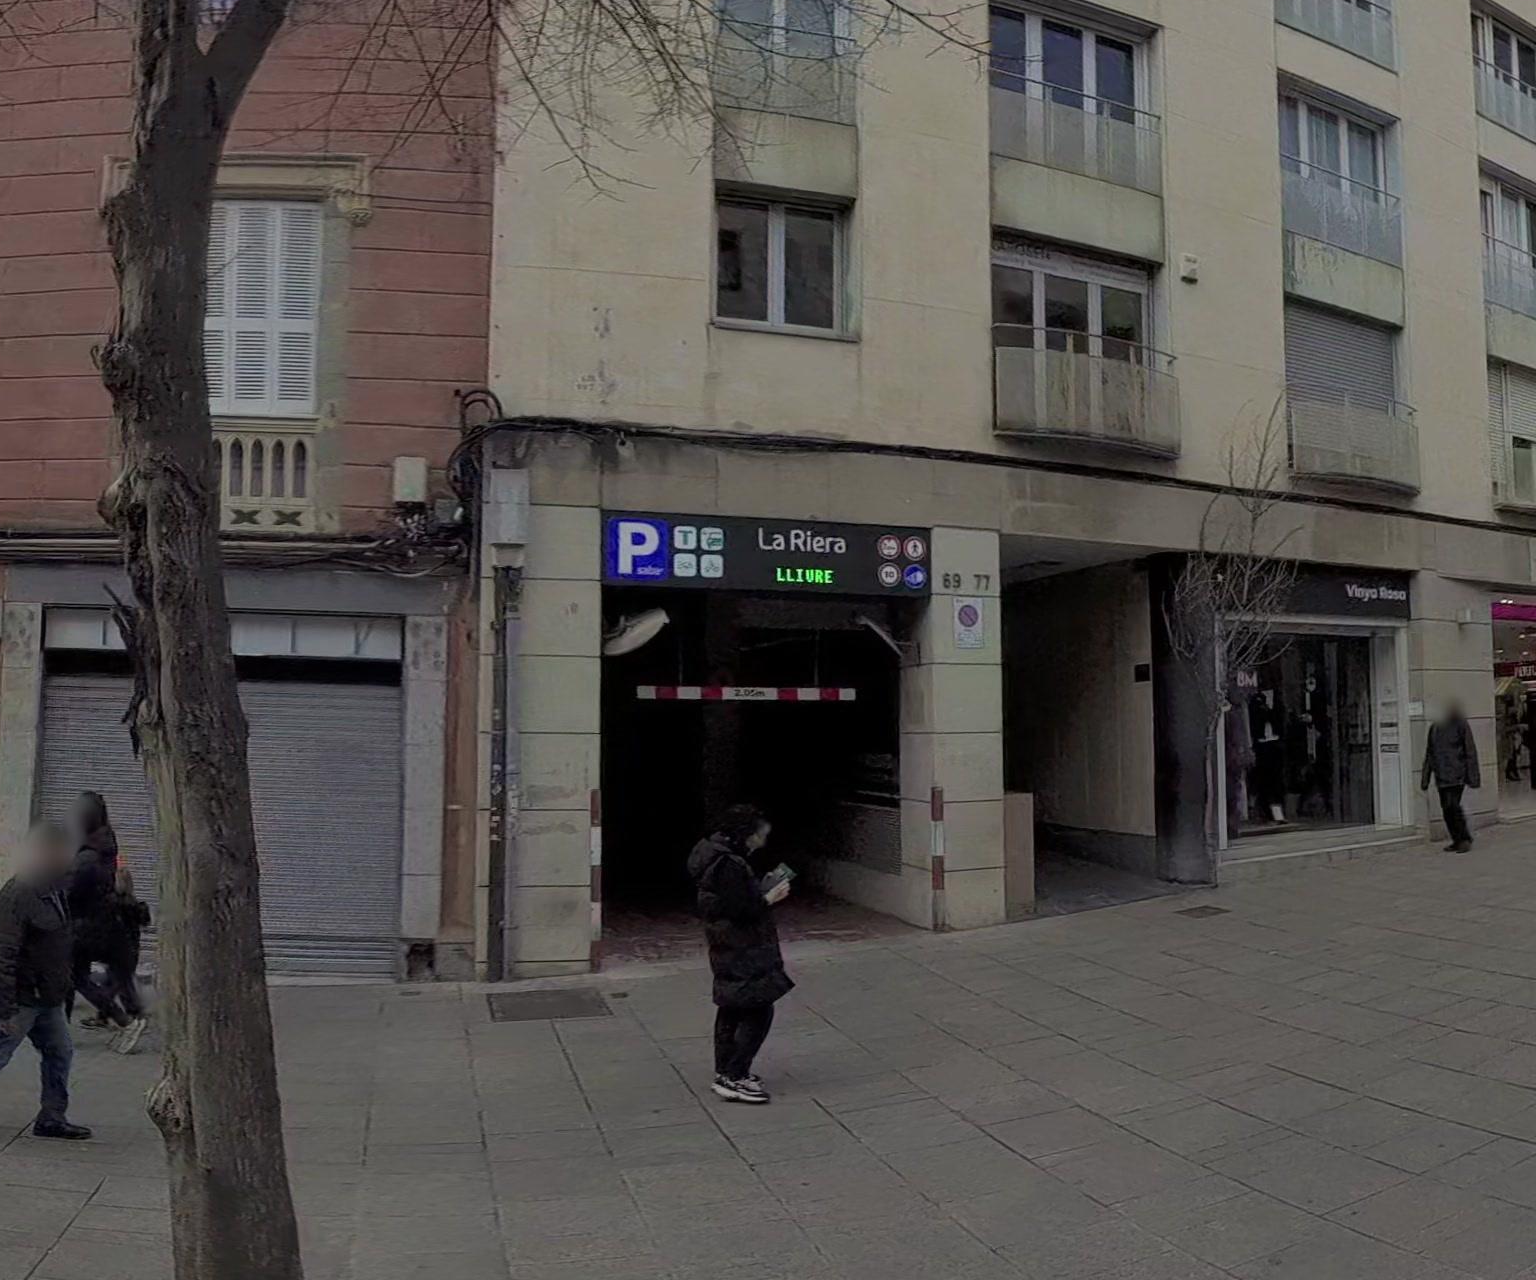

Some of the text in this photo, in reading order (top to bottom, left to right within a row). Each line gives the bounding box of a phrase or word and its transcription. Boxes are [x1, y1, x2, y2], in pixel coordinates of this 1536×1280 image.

[617, 521, 660, 575] P
[758, 526, 847, 555] La Riera
[942, 572, 991, 591] 69 77
